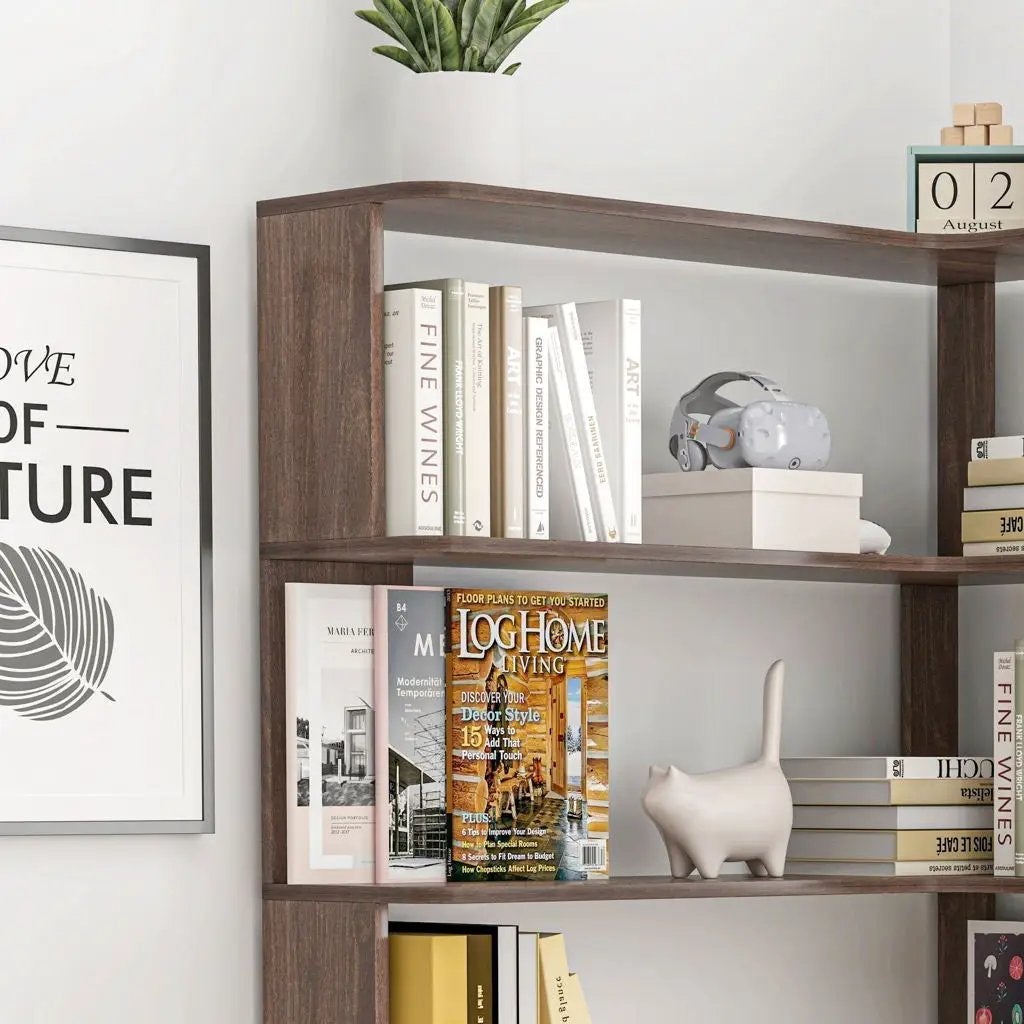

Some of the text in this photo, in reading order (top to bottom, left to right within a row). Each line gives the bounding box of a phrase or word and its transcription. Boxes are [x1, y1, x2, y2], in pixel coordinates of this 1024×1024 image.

[943, 219, 1004, 233] August
[420, 324, 437, 389] FINE
[626, 358, 639, 396] ART
[421, 405, 438, 503] WINES
[1000, 517, 1023, 536] CAFÉ
[456, 593, 605, 608] FLOOR PLANS TO GET YOU STARTED
[396, 603, 407, 612] B4
[327, 626, 355, 636] MARIA
[502, 656, 566, 674] LIVING
[461, 691, 525, 704] DISCOVER YOUR
[461, 706, 541, 725] Decor Style
[997, 683, 1012, 743] FINE
[461, 725, 484, 748] 15
[485, 725, 516, 737] Ways to
[485, 737, 521, 748] Add That
[461, 750, 523, 760] Personal Touch
[997, 756, 1012, 846] WINES
[461, 813, 492, 824] PLUS:
[468, 828, 480, 837] Tips
[488, 829, 512, 838] Improve
[527, 828, 547, 837] Design
[483, 841, 497, 849] Plan
[497, 841, 518, 850] Special
[468, 853, 490, 861] Secrets
[507, 852, 526, 861] Dream
[534, 852, 554, 861] Budget
[461, 864, 556, 874] How Chopsticks Affect Log Prices
